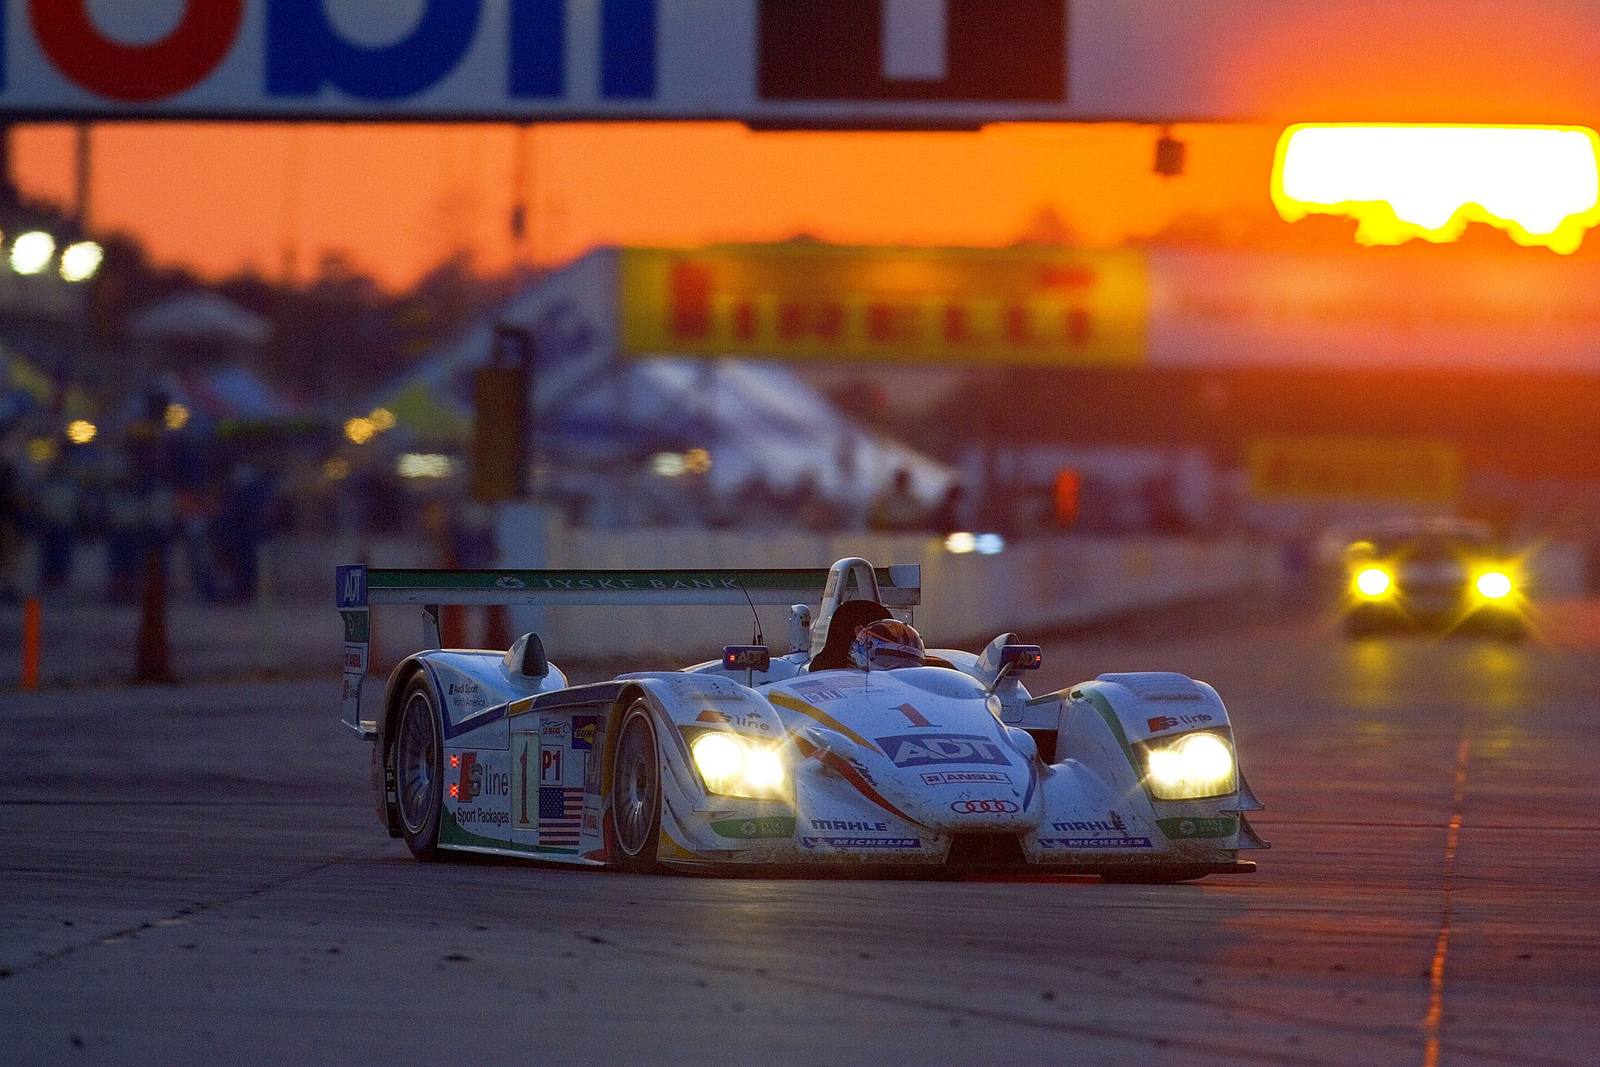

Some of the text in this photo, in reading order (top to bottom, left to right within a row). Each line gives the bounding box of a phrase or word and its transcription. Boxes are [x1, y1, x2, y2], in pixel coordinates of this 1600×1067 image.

[344, 570, 362, 602] ADT
[649, 579, 742, 589] BANK
[465, 684, 479, 695] Sport
[736, 714, 770, 731] line
[888, 703, 942, 728] 1
[1179, 714, 1213, 724] line
[893, 739, 994, 763] ADT
[542, 750, 561, 781] P1
[485, 765, 509, 796] line
[519, 741, 530, 823] 1
[457, 807, 510, 827] Sport Packages
[811, 819, 889, 832] MAHLE
[1052, 820, 1127, 832] MAHLE
[834, 839, 914, 847] MICHELIN
[1069, 839, 1145, 847] MICHELIN
